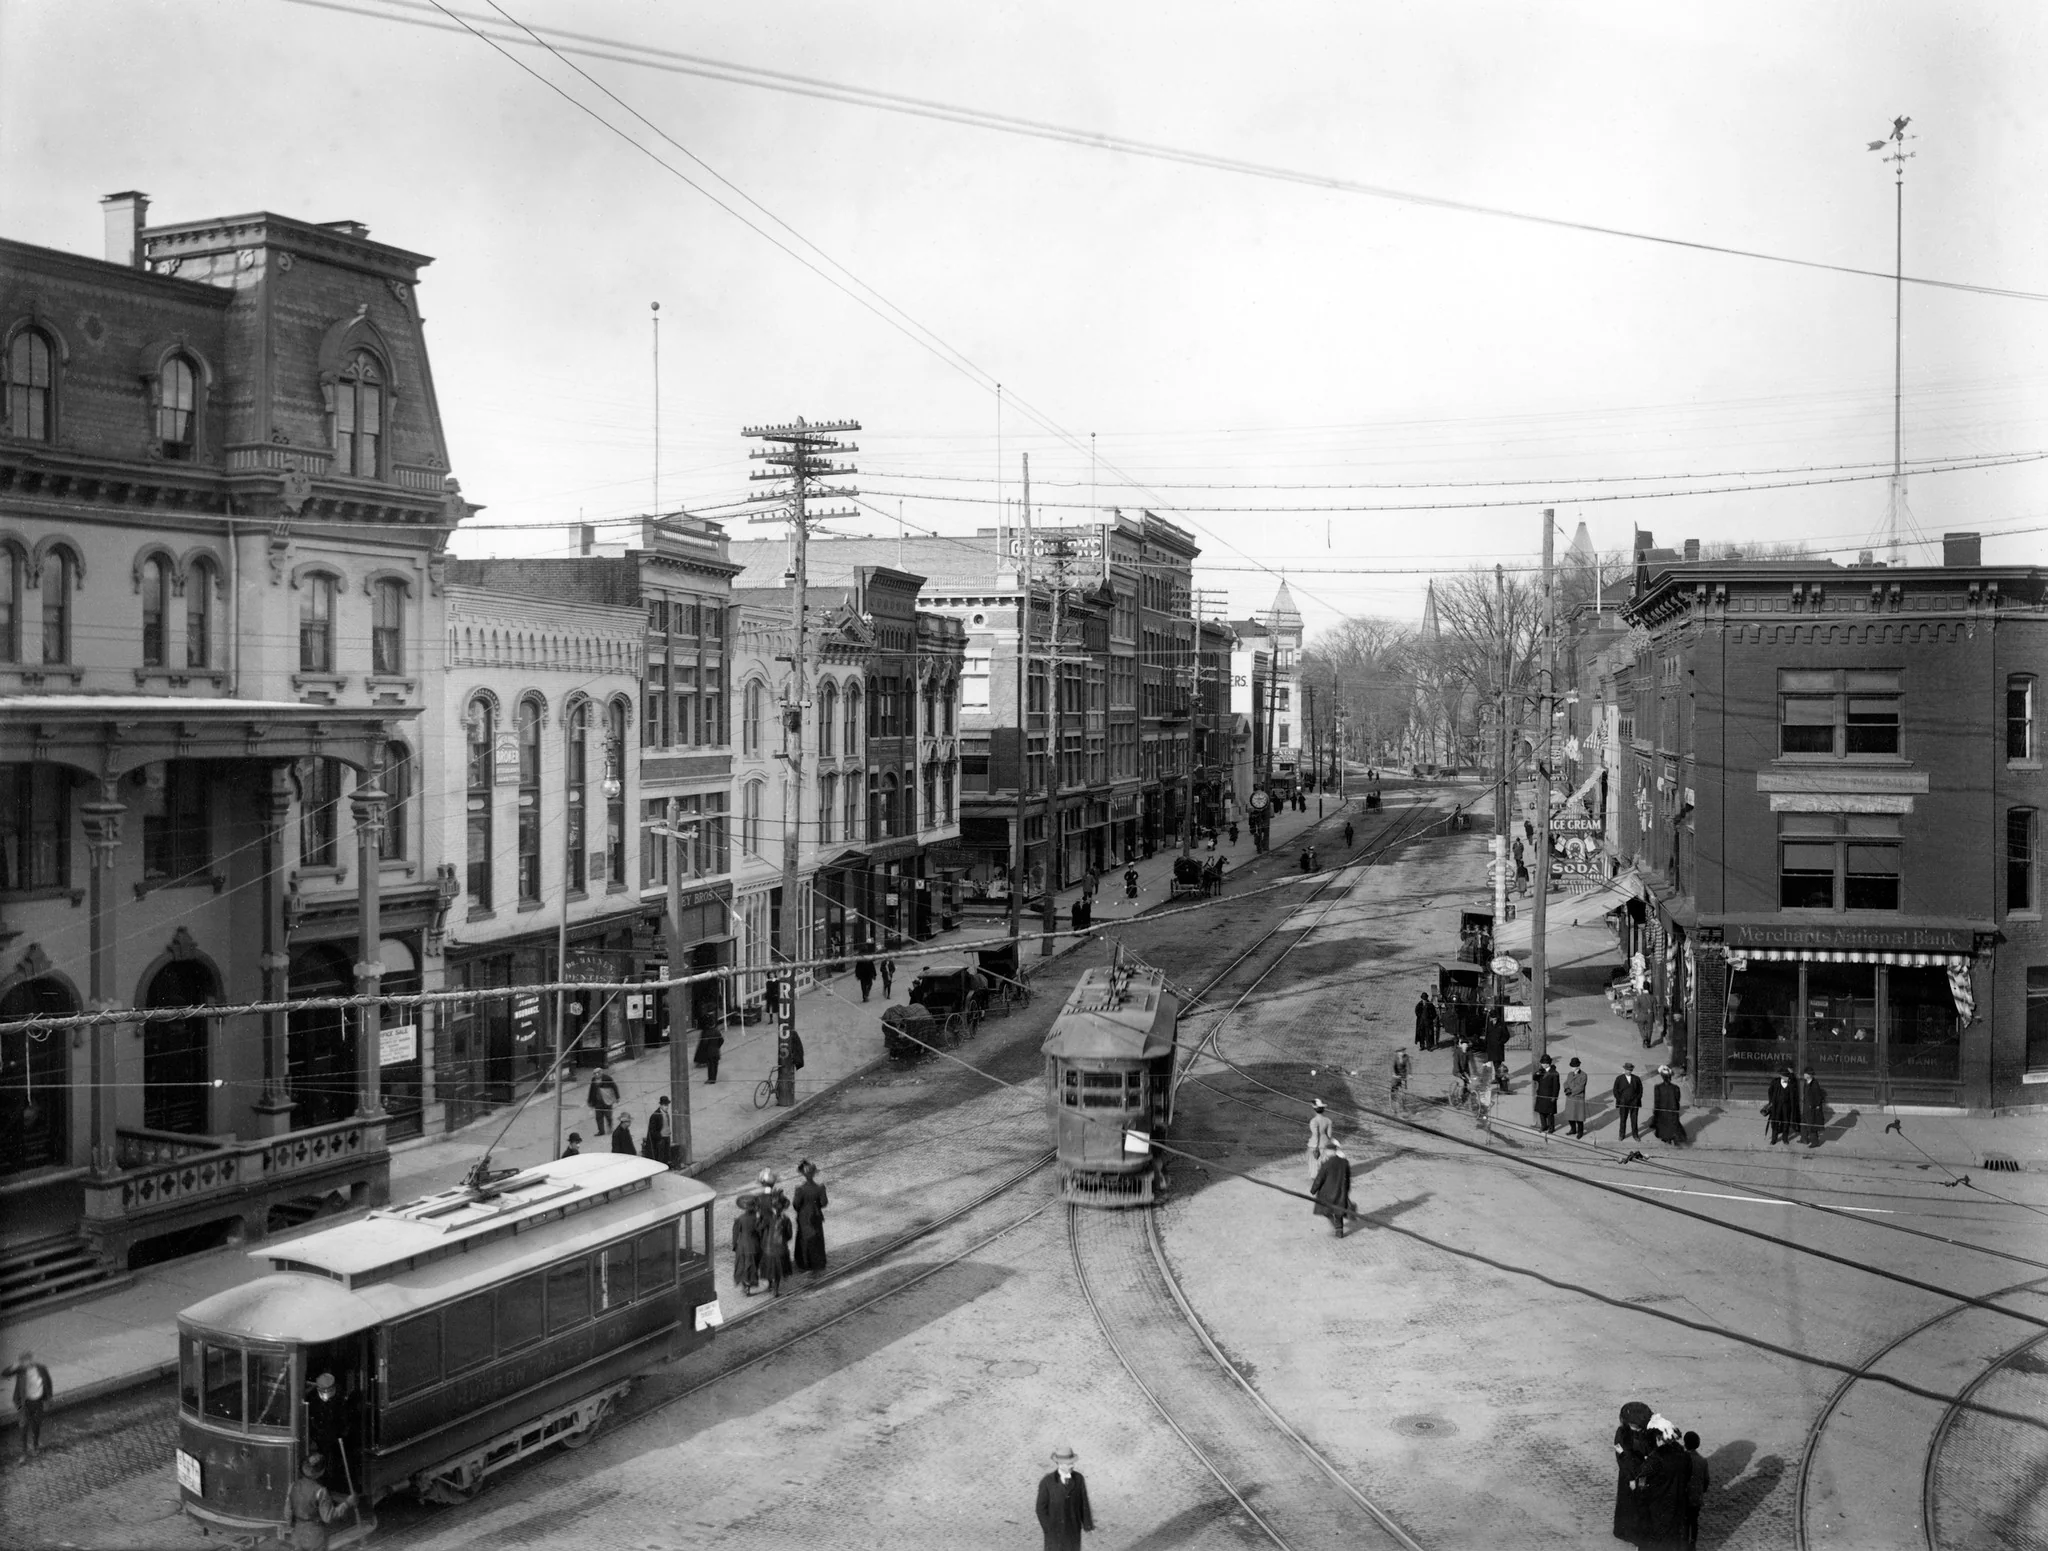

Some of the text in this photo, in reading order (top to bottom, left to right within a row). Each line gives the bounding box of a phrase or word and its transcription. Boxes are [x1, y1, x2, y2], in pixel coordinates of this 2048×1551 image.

[1550, 820, 1601, 830] ICE CREAM
[1552, 863, 1600, 873] SODA
[695, 890, 715, 905] BROS.
[1738, 924, 1959, 949] Merchants National Bank
[565, 973, 613, 982] DENTIST
[779, 969, 792, 1059] DRUGS
[1733, 1051, 1938, 1066] MERCHANTS NATIONAL BANK
